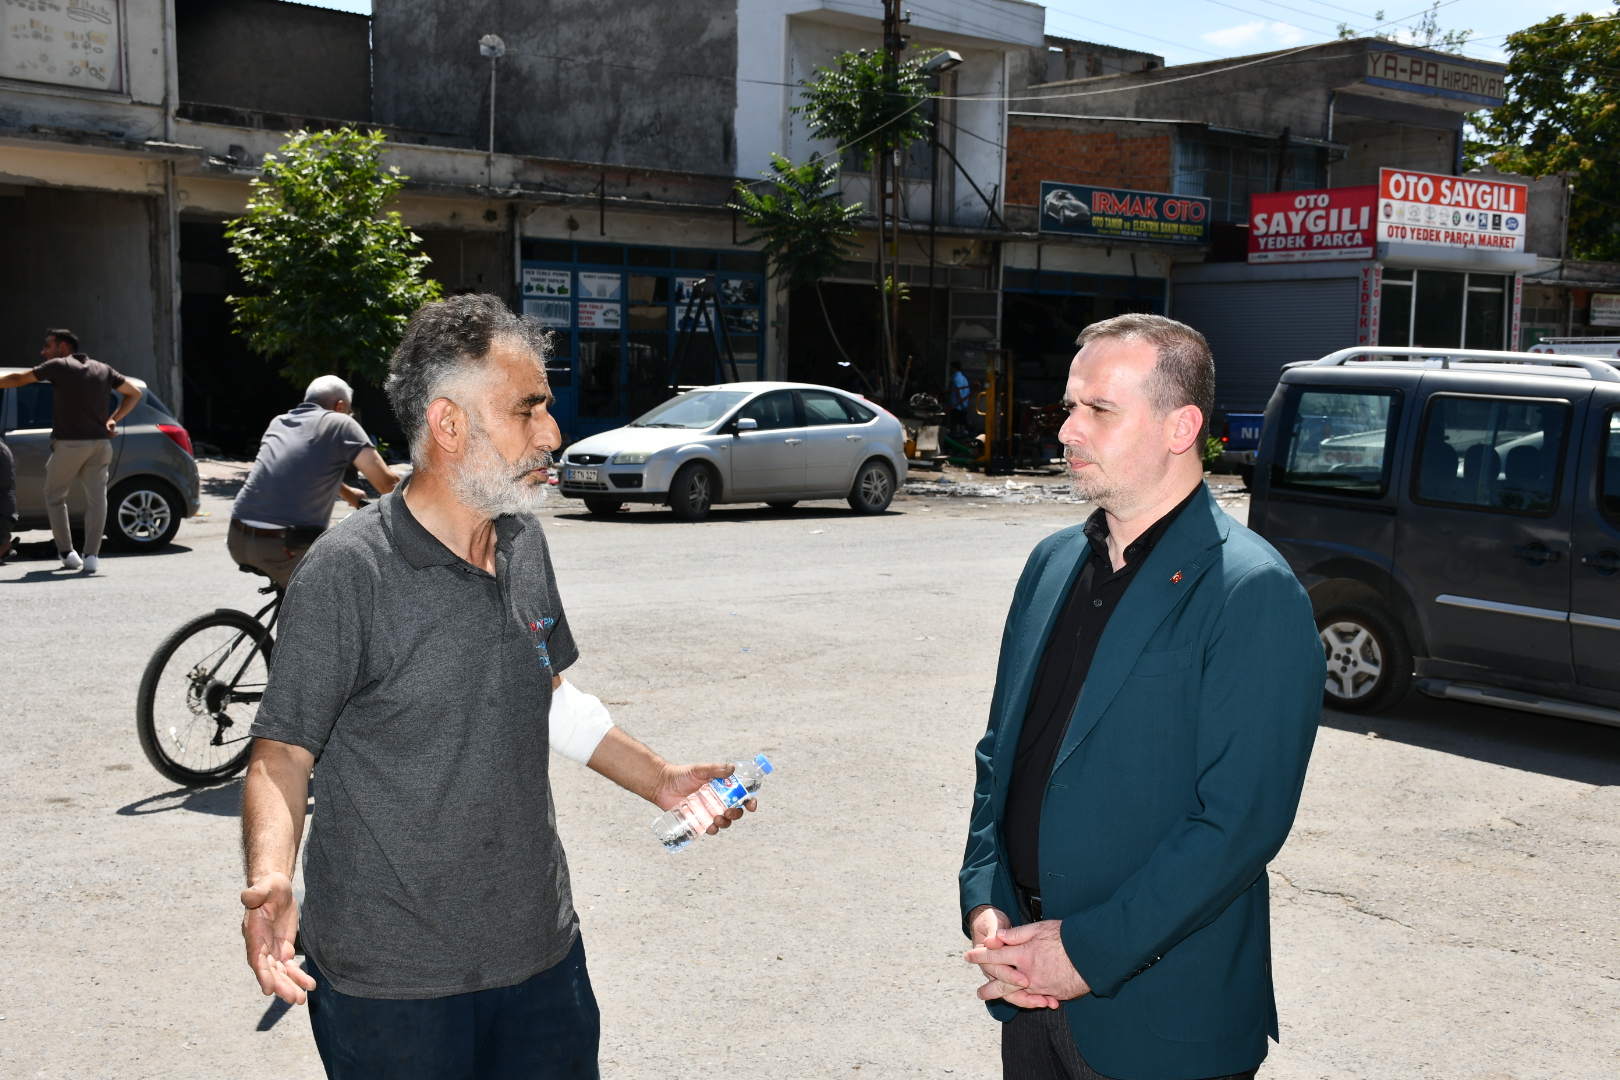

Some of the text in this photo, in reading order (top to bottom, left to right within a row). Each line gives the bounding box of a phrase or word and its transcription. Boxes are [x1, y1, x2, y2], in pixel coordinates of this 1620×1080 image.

[1369, 53, 1504, 97] YA-PA HIRDAVAT
[1092, 191, 1206, 222] IRMAK OTO
[1294, 194, 1330, 209] OTO
[1389, 173, 1515, 212] OTO SAYGILI
[1092, 216, 1104, 228] OTO
[1253, 206, 1370, 236] SAYGILI
[1258, 232, 1363, 250] YEDEK PARÇA
[1387, 225, 1516, 249] OTO YEDEK PARÇA MARKET
[1360, 268, 1371, 328] YEDEK
[1373, 269, 1381, 298] OTO
[1514, 277, 1522, 305] OTO
